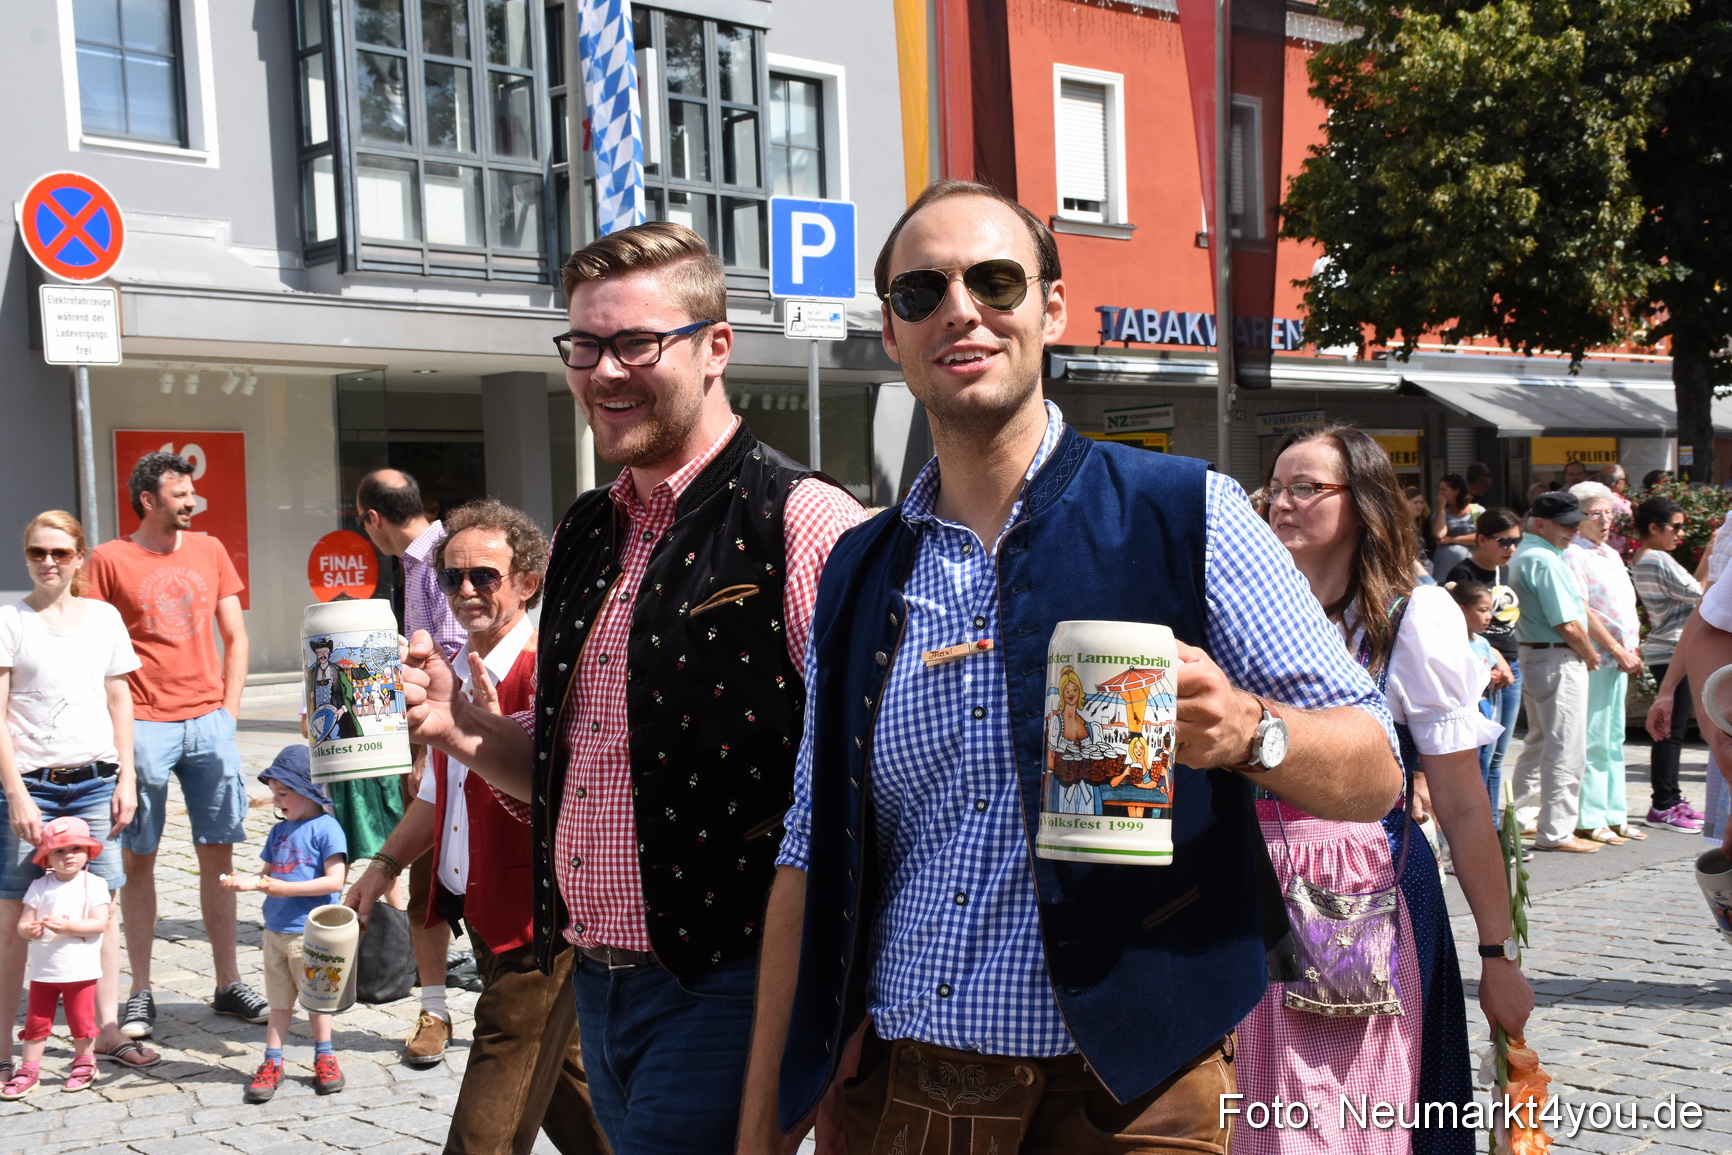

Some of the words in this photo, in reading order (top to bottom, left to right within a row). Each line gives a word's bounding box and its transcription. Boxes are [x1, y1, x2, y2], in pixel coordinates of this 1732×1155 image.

[791, 211, 836, 284] P
[47, 294, 111, 308] Elektrofahrzeuge
[57, 312, 89, 322] während
[92, 313, 105, 322] des
[56, 328, 108, 340] Ladevorgangs
[76, 345, 92, 355] frei
[1107, 415, 1129, 429] NZ
[319, 554, 368, 571] FINAL
[323, 570, 365, 588] SALE
[1077, 652, 1171, 668] Lammsbräu
[357, 741, 383, 752] 2008
[1043, 816, 1102, 830] Volksfest
[1108, 820, 1144, 832] 1999
